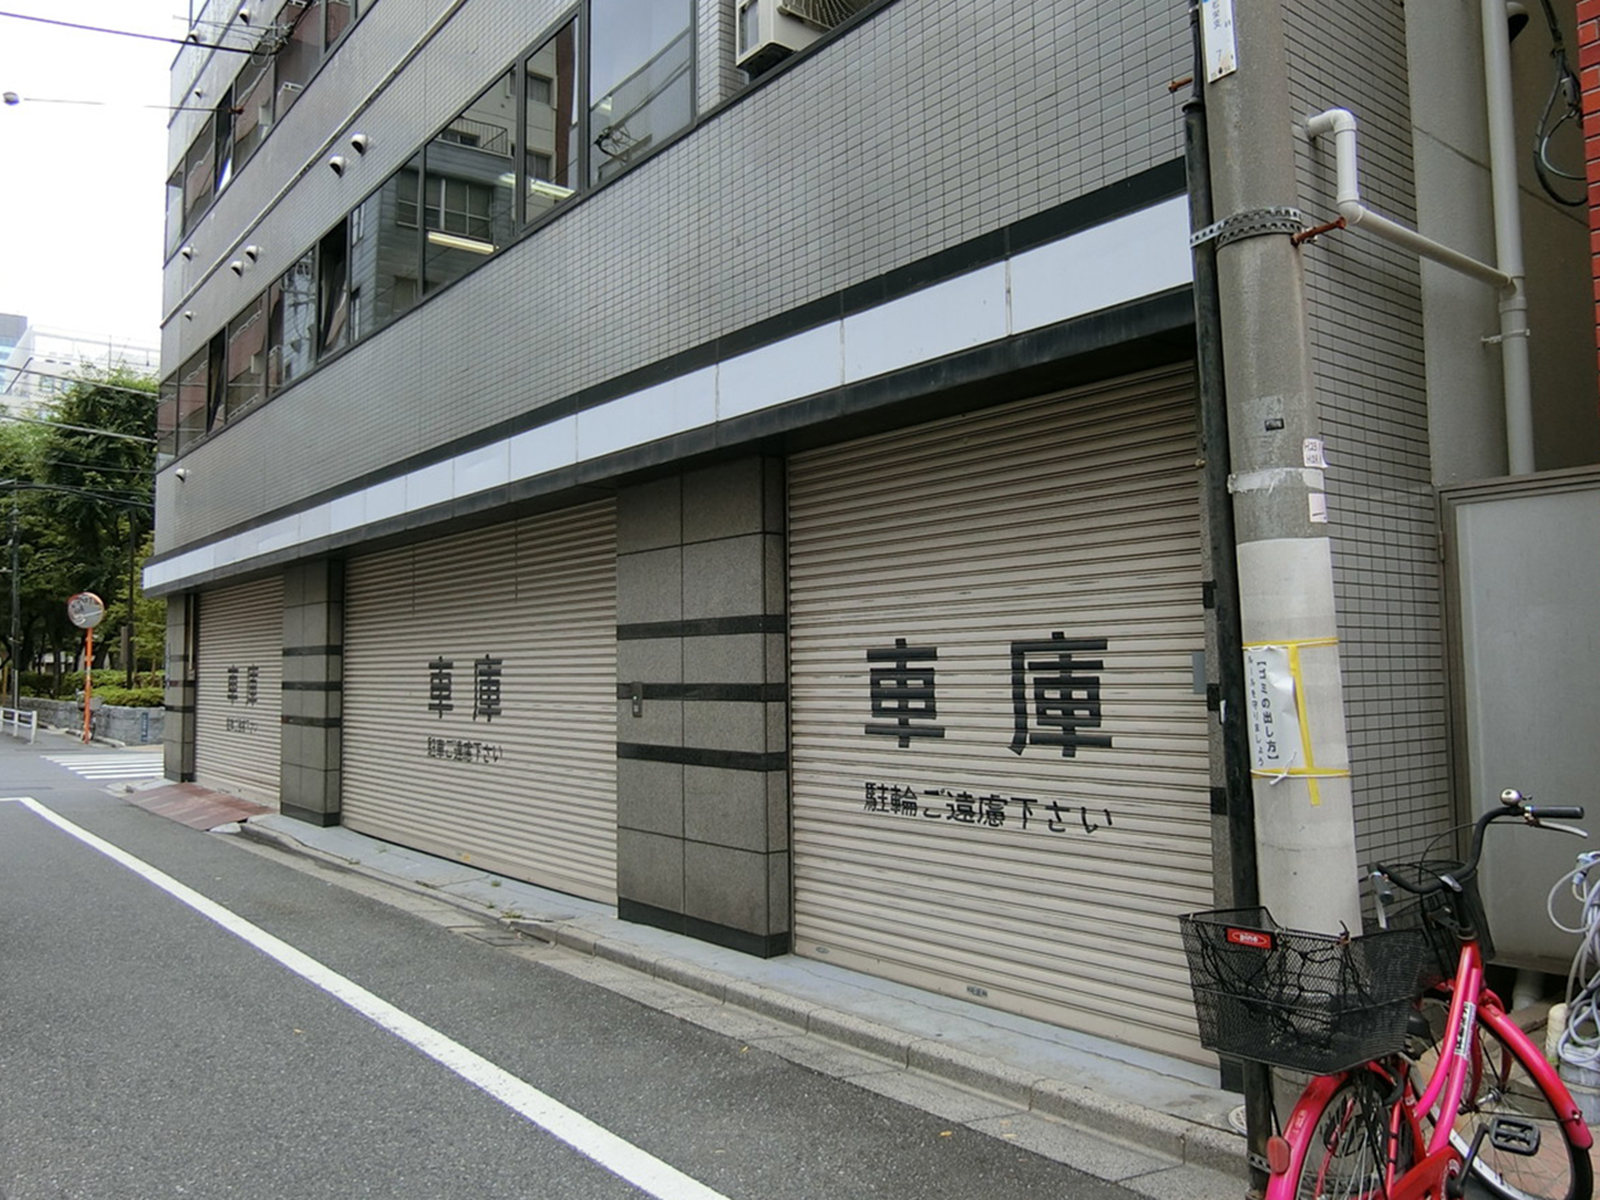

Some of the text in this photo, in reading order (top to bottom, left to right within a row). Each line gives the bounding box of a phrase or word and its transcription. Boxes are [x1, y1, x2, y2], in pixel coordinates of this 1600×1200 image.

[428, 653, 503, 722] 車庫
[864, 631, 1112, 758] 車庫
[863, 781, 1113, 834] 駐輪ご遠慮下さい
